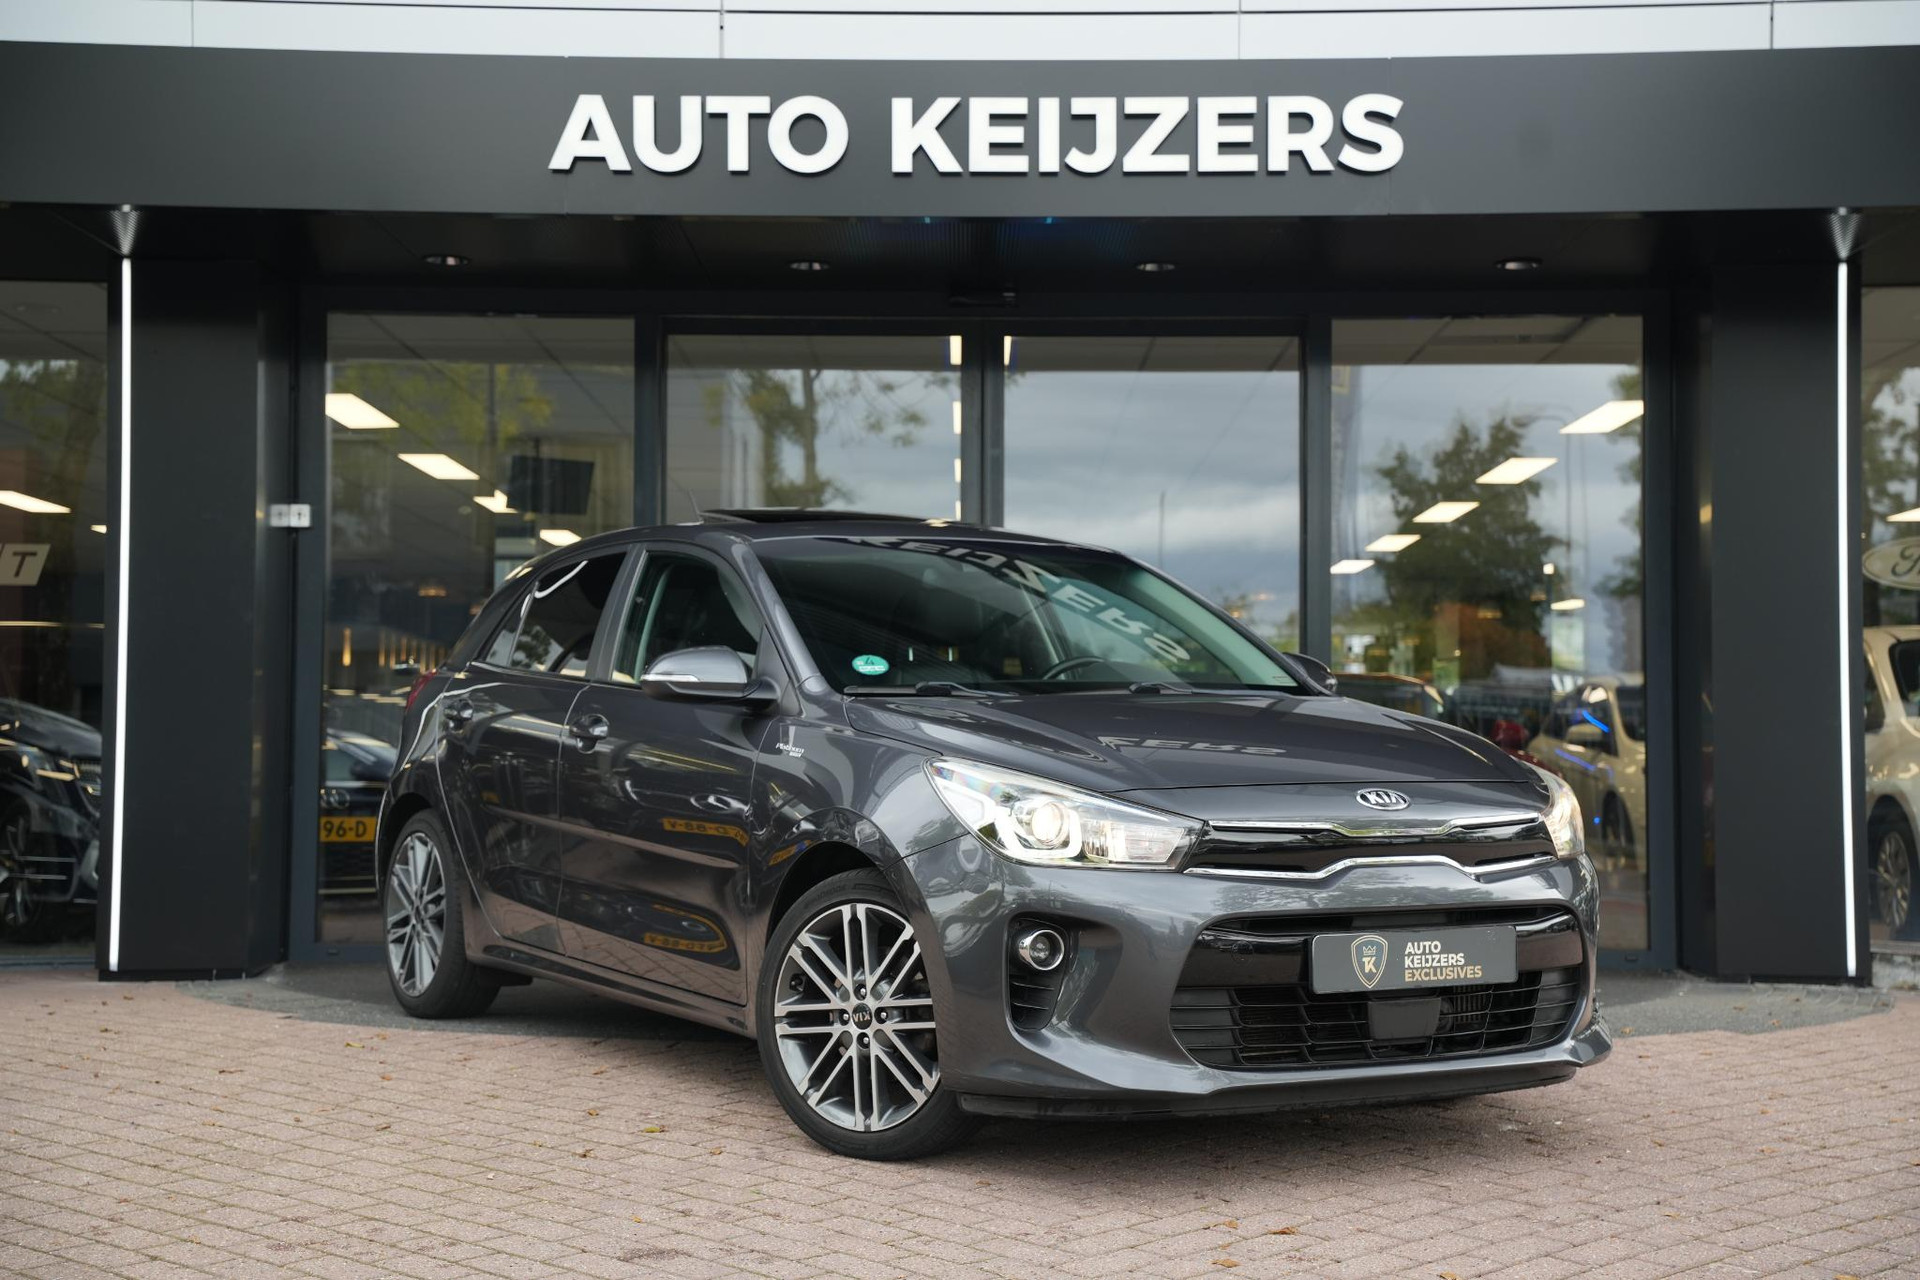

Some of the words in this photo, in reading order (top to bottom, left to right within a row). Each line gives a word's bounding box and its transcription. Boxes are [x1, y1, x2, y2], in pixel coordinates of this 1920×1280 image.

[548, 94, 849, 174] AUTO
[891, 93, 1404, 174] KEIJZERS
[1361, 791, 1406, 805] KIA
[322, 820, 367, 838] 96-D
[1405, 941, 1442, 954] AUTO
[1405, 953, 1465, 968] KEIJZERS
[1405, 966, 1482, 982] EXCLUSIVES
[853, 1011, 871, 1022] KIA
